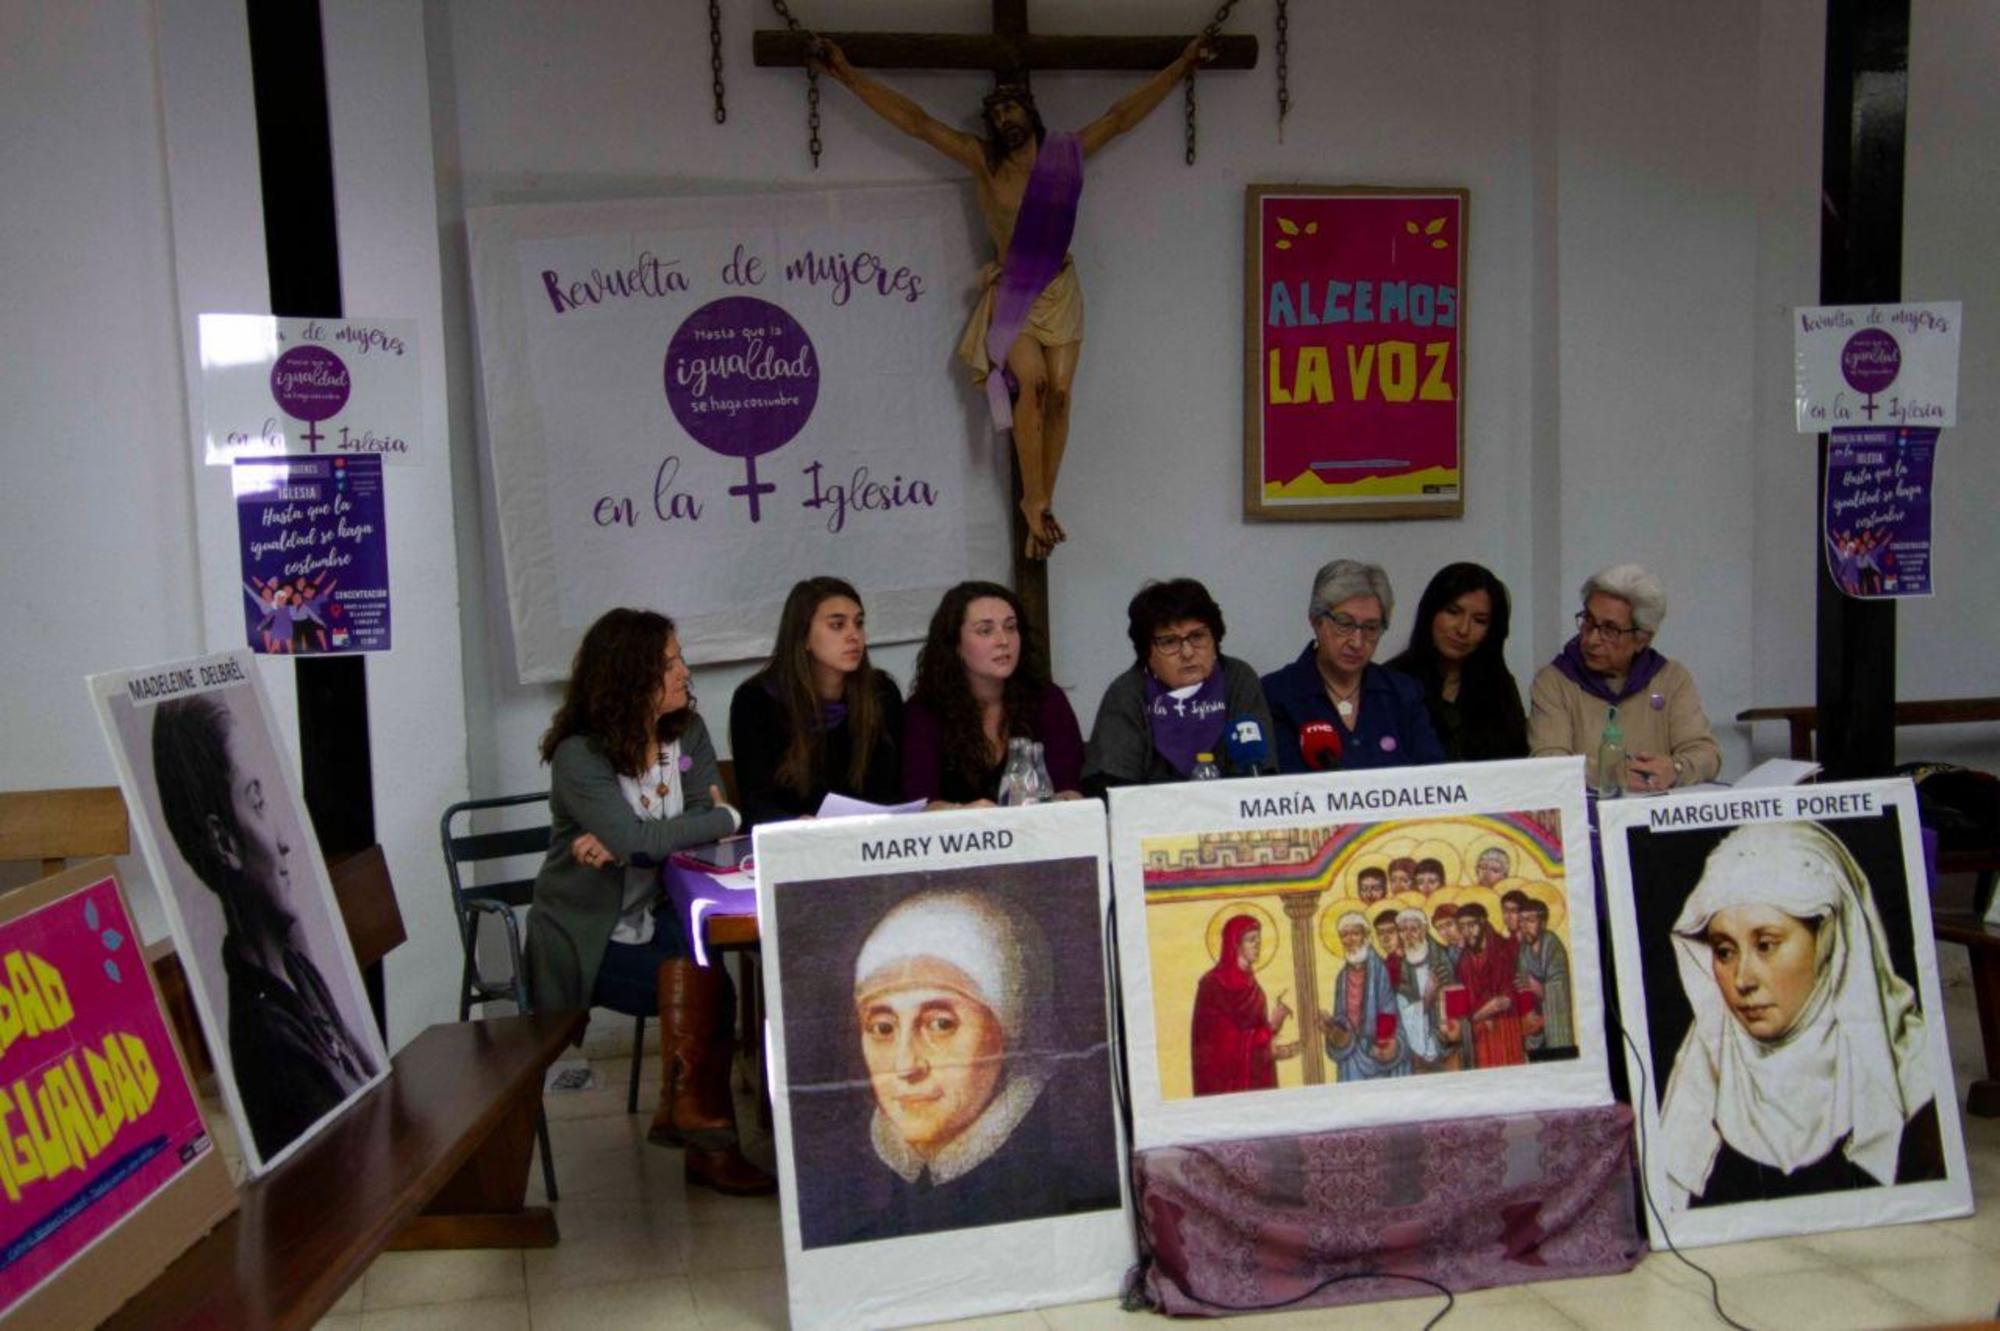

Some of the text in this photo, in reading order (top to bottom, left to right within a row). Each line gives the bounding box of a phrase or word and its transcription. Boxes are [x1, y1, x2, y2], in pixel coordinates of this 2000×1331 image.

[542, 244, 925, 313] Revuelta de mujeres
[1268, 280, 1457, 328] ALCEMOS
[1866, 306, 1883, 324] de
[1891, 309, 1950, 334] mujeres
[303, 321, 324, 341] de
[336, 326, 405, 355] mujeres
[742, 328, 764, 342] que
[277, 366, 347, 391] igualdad
[677, 339, 812, 397] igualdad
[1269, 339, 1455, 404] LA VOZ
[691, 402, 707, 413] se
[1810, 405, 1826, 419] en
[1833, 392, 1850, 420] la
[227, 431, 248, 447] en
[337, 426, 407, 453] Iglesia
[278, 485, 317, 500] IGLESIA
[593, 456, 938, 533] en la Iglesia
[262, 494, 352, 527] Hasta que la
[251, 516, 374, 562] igualdad se haga
[284, 547, 352, 576] costumbre
[128, 668, 197, 700] MADELEINE
[1240, 784, 1468, 819] MARÍA MAGDALENA
[1650, 792, 1873, 828] MARGUERITE PORETE
[862, 829, 1014, 862] MARY WARD
